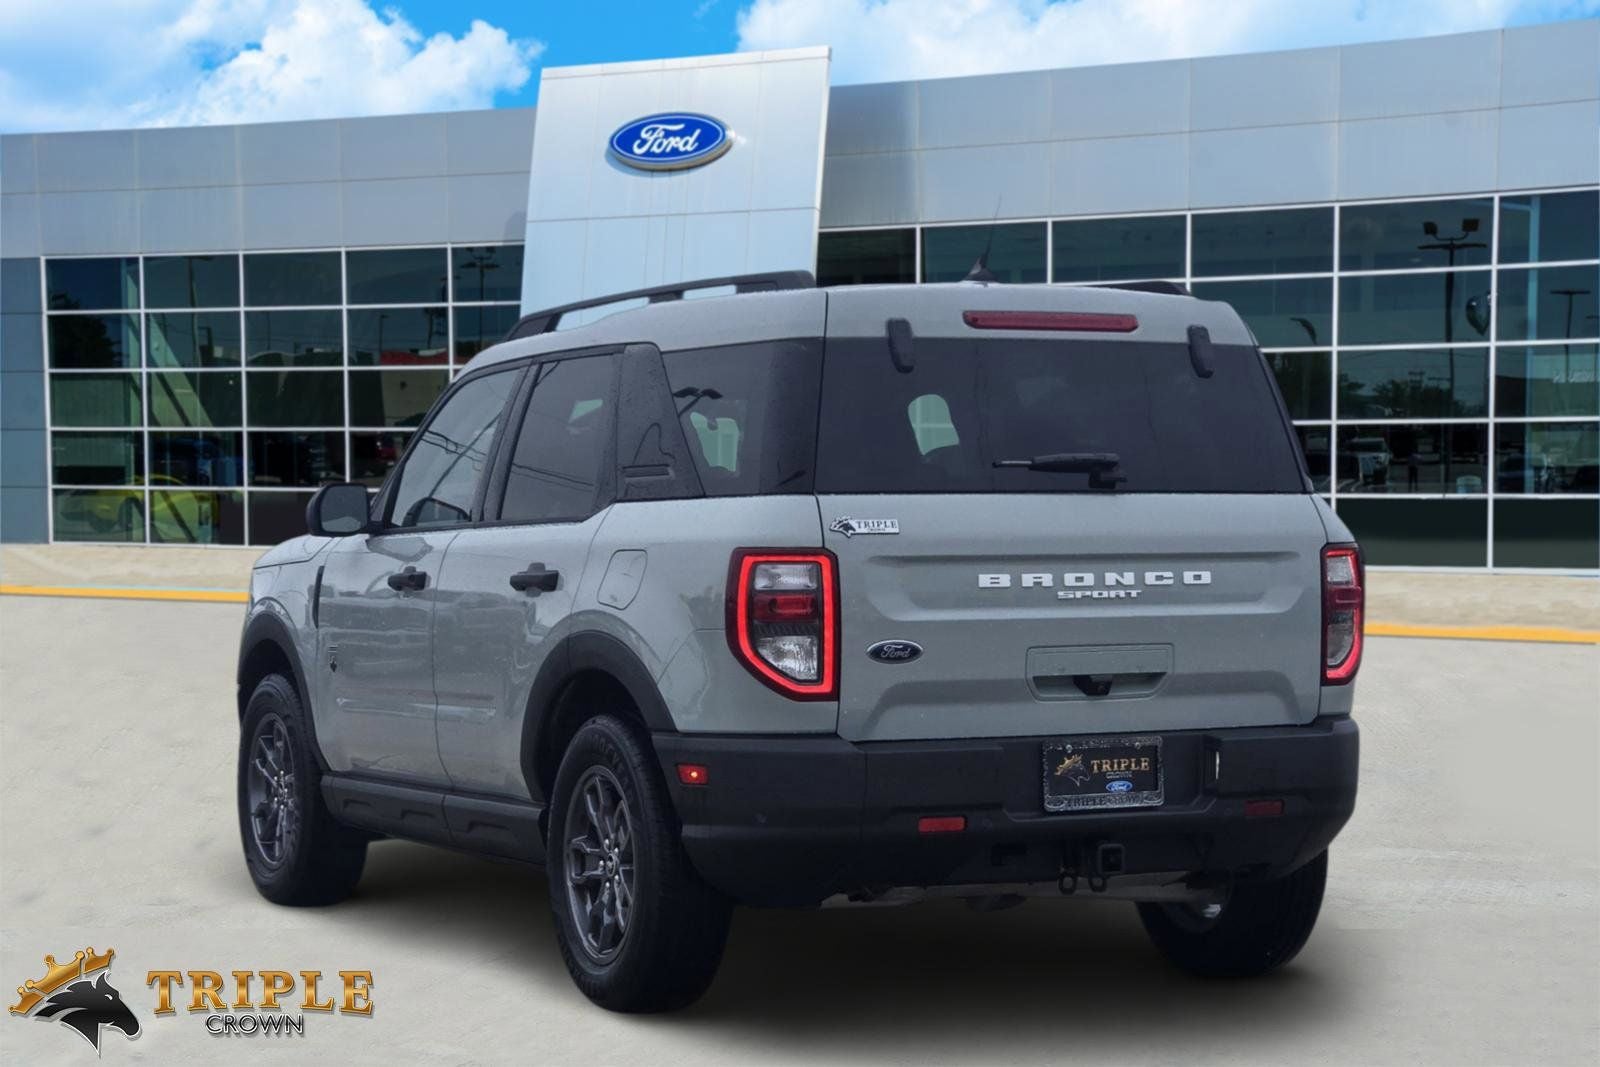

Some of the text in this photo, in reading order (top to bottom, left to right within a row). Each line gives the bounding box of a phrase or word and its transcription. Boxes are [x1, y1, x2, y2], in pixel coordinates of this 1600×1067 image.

[632, 123, 702, 155] Ford
[856, 520, 897, 529] TRIPLE
[978, 571, 1212, 588] BRONCO
[1057, 590, 1142, 599] SPORT
[880, 645, 911, 658] Ford
[1090, 757, 1150, 773] TRIPLE
